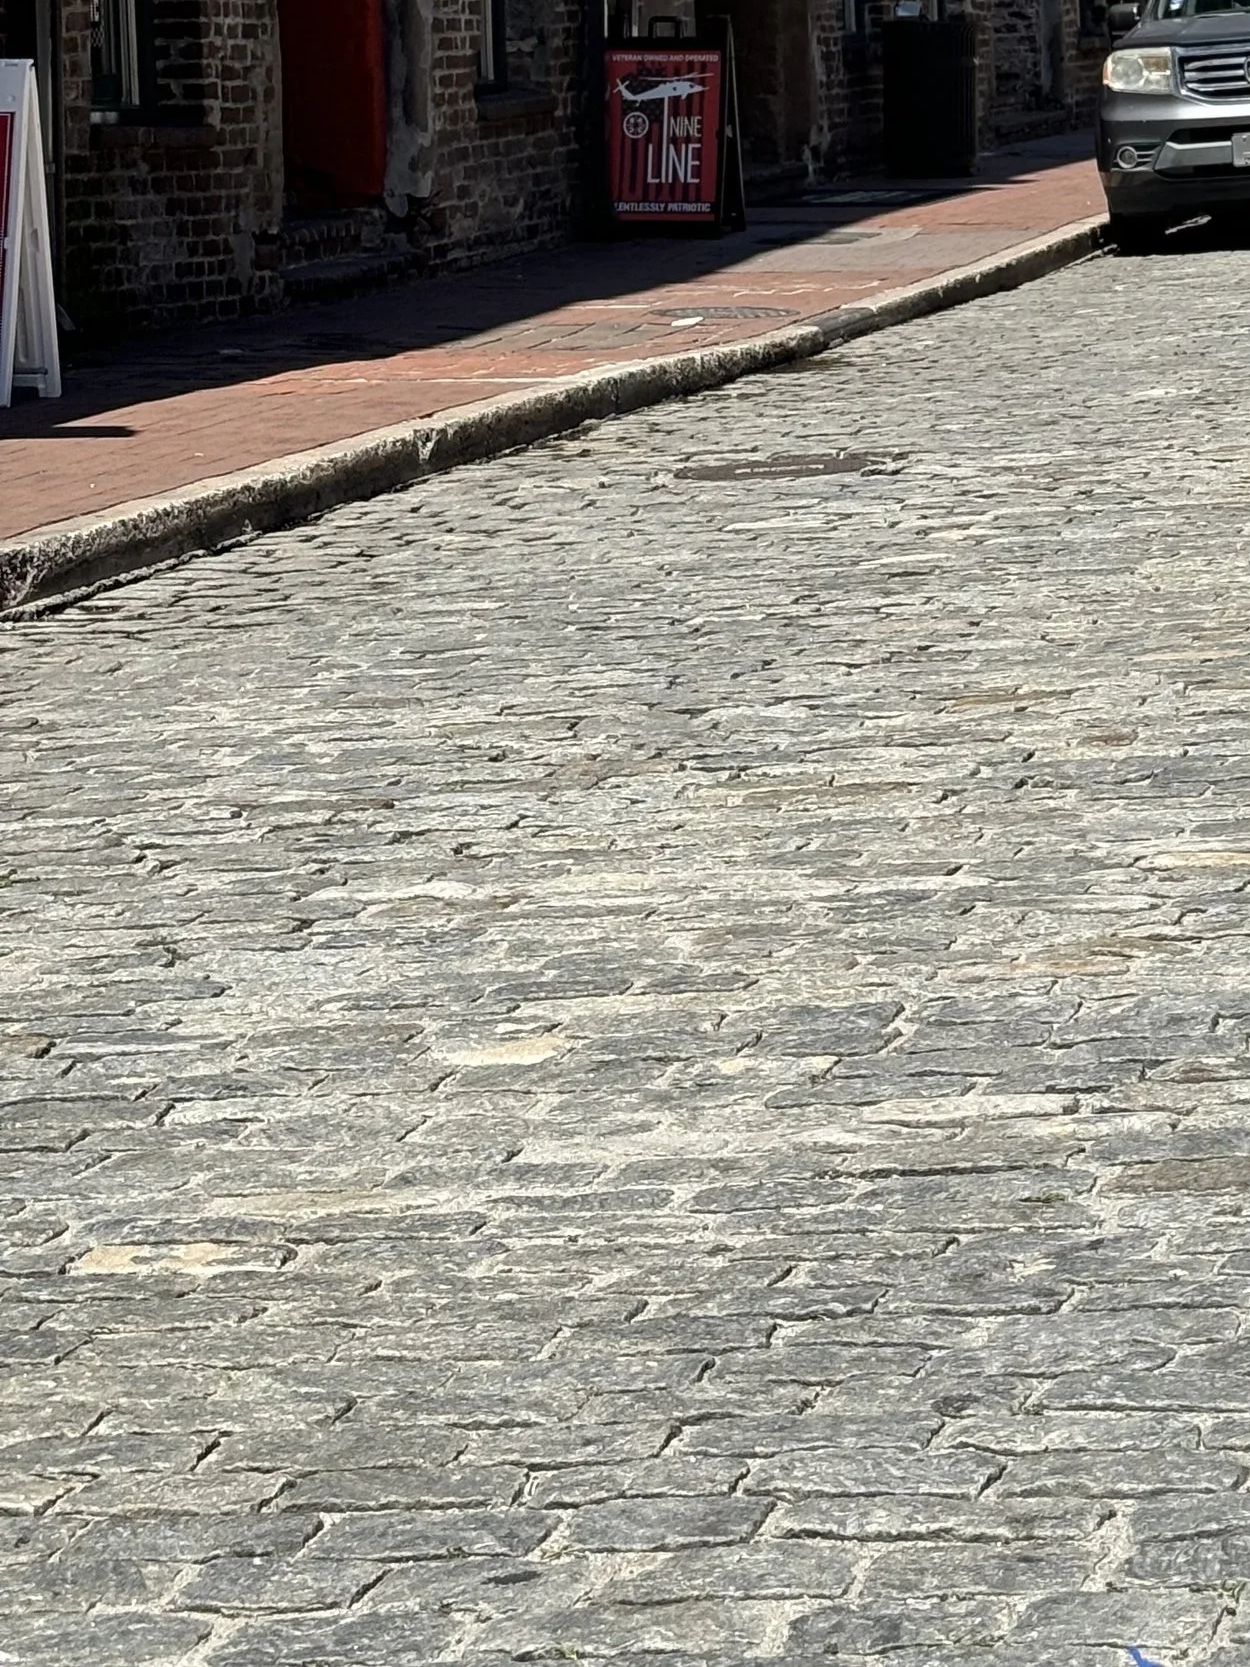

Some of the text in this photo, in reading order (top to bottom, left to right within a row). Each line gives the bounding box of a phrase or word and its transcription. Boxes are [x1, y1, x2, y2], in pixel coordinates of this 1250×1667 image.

[612, 53, 719, 62] VETERAN OWNED AND OPERATED
[670, 116, 702, 137] NINE
[647, 143, 702, 184] LINE
[667, 201, 710, 212] PATRIOTIC
